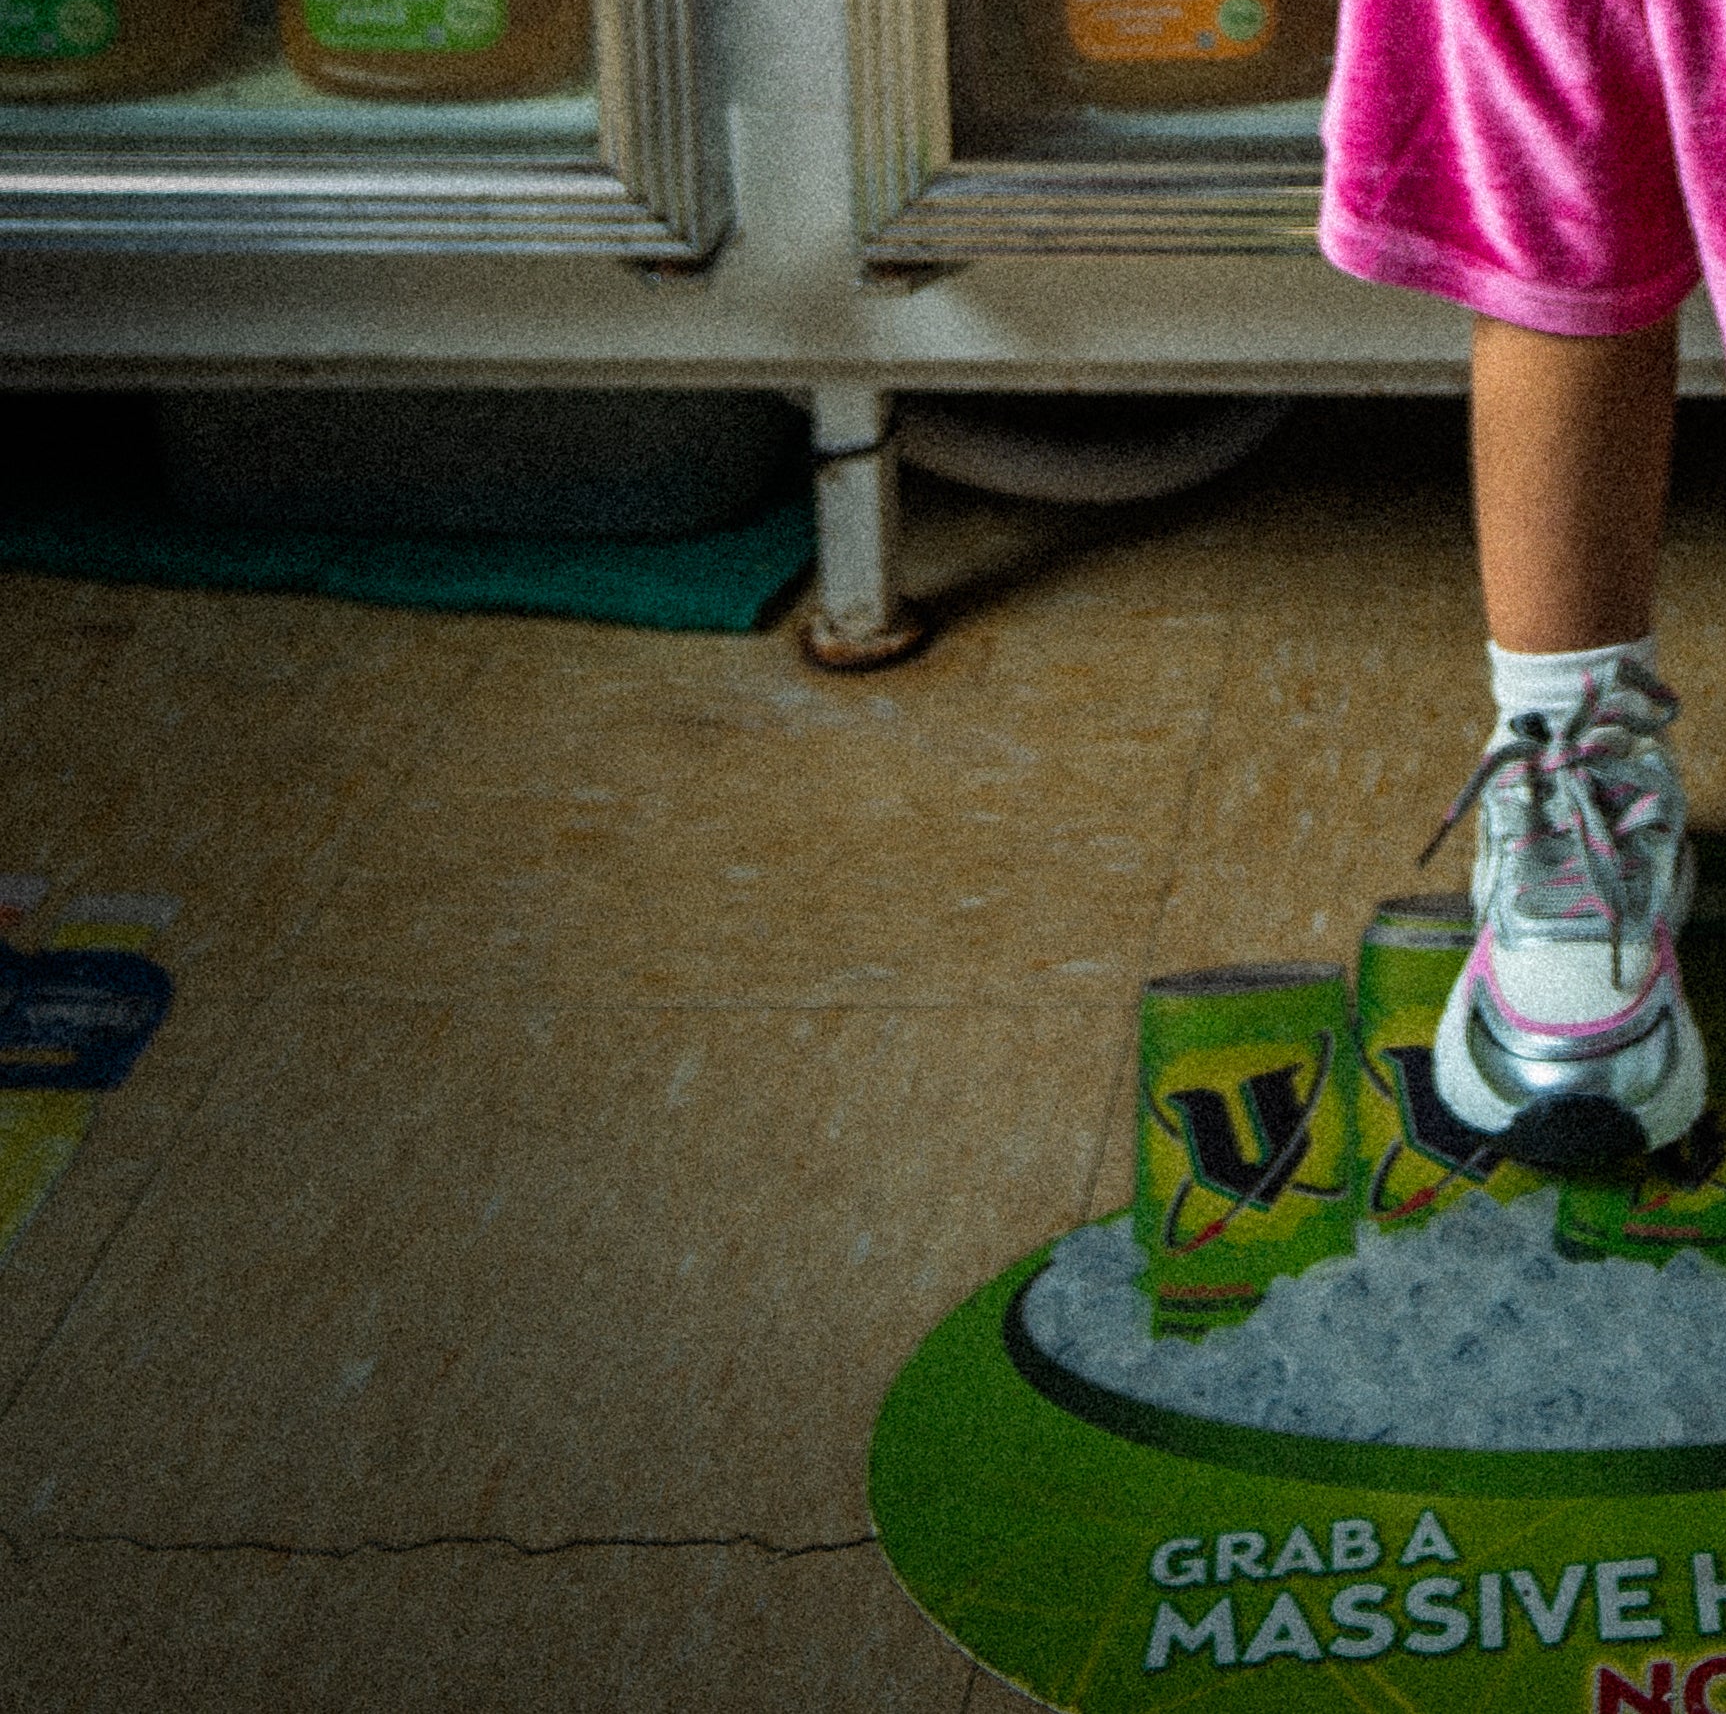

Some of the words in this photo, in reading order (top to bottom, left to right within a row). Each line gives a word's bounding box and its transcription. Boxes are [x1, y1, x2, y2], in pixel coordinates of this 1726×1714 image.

[1149, 1516, 1383, 1590] GRAB
[1401, 1508, 1460, 1566] A
[1142, 1557, 1666, 1673] MASSIVE
